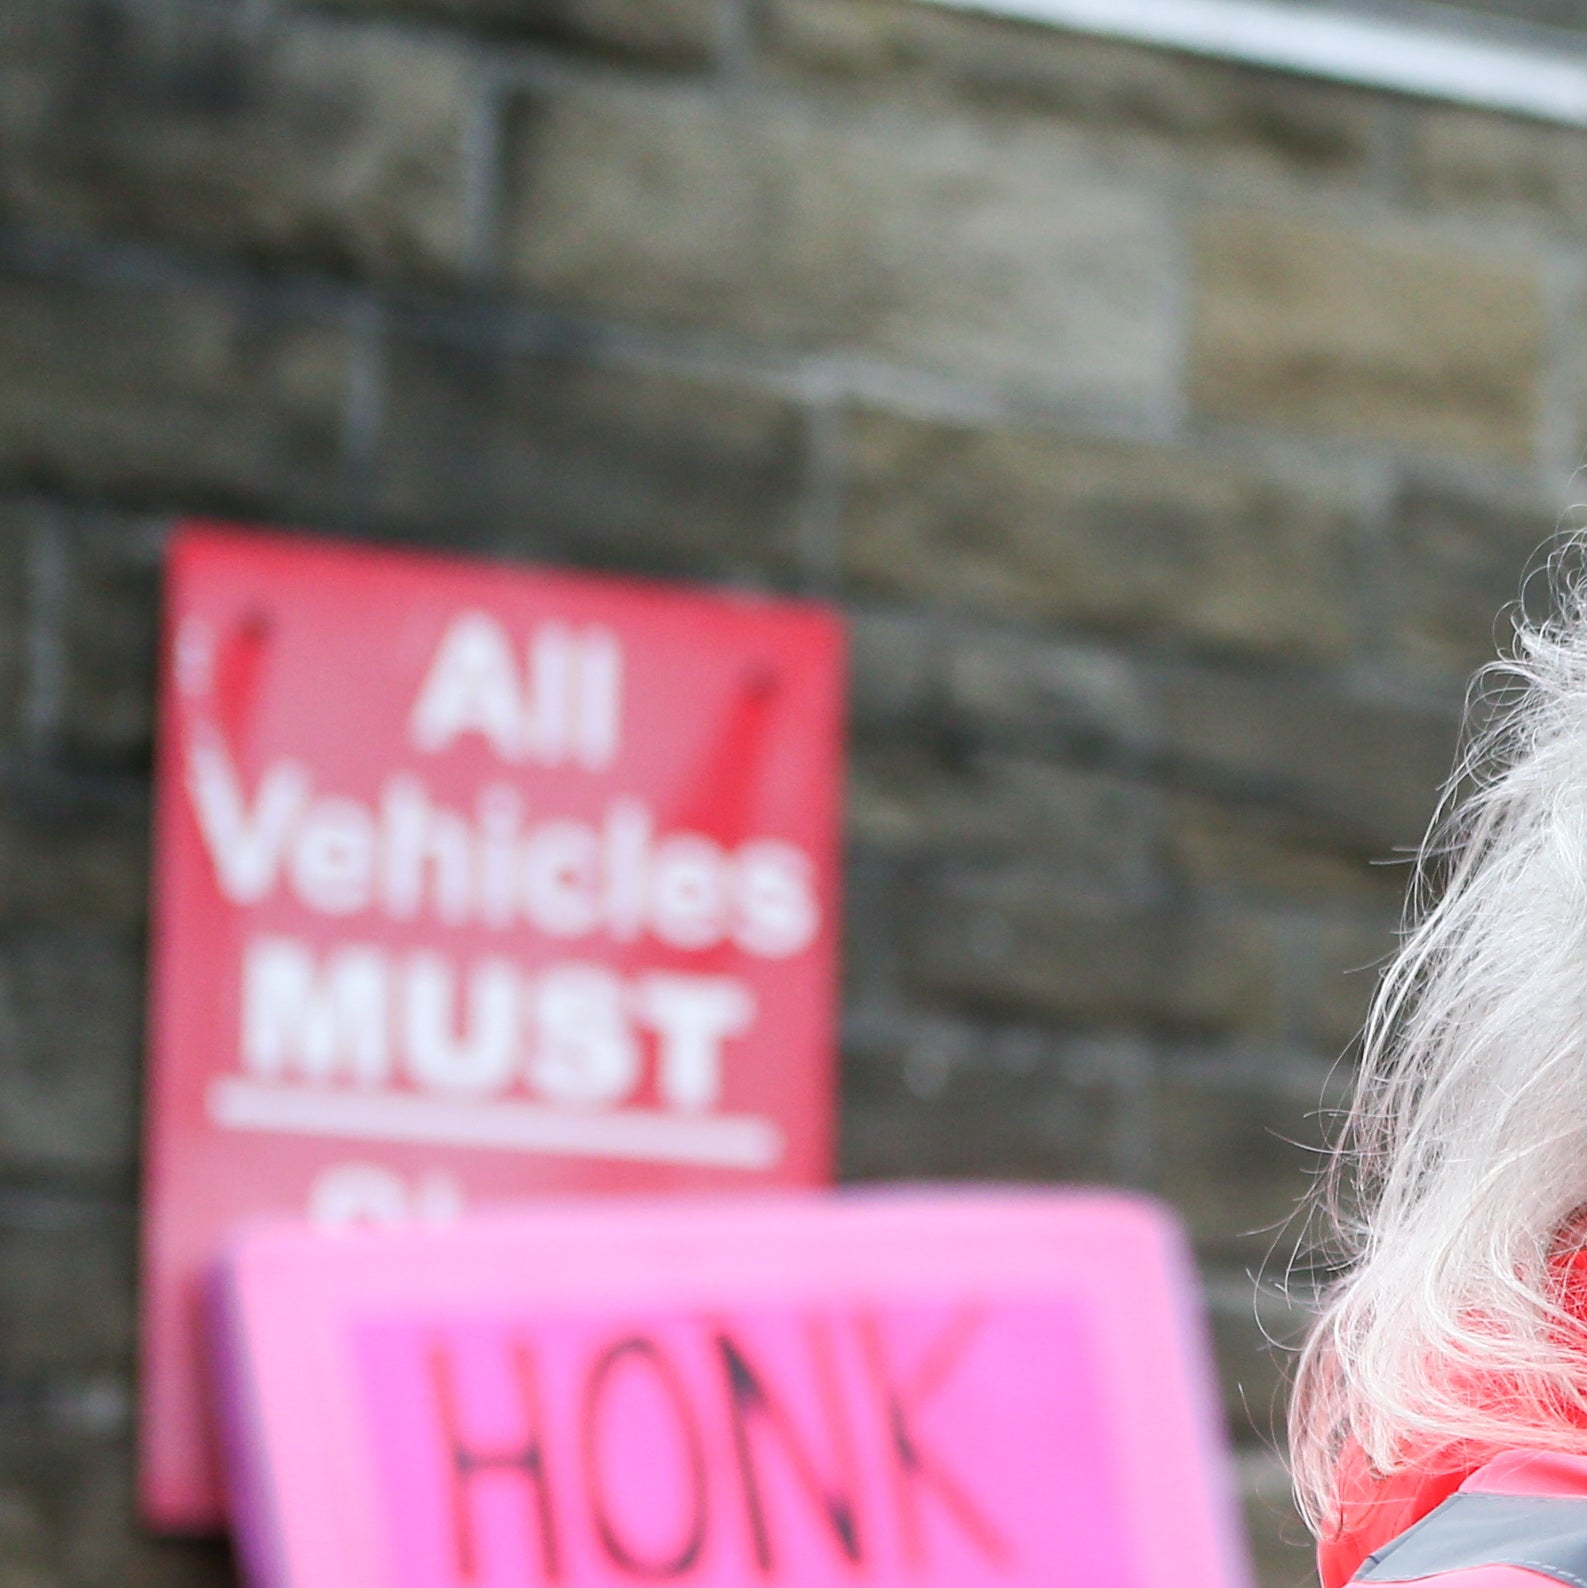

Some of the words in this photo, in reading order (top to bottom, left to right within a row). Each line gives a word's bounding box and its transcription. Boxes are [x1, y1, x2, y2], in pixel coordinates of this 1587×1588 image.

[411, 611, 622, 770] All
[186, 720, 820, 957] Vehicles
[242, 933, 755, 1109] MUST
[424, 1302, 1010, 1588] HONK
